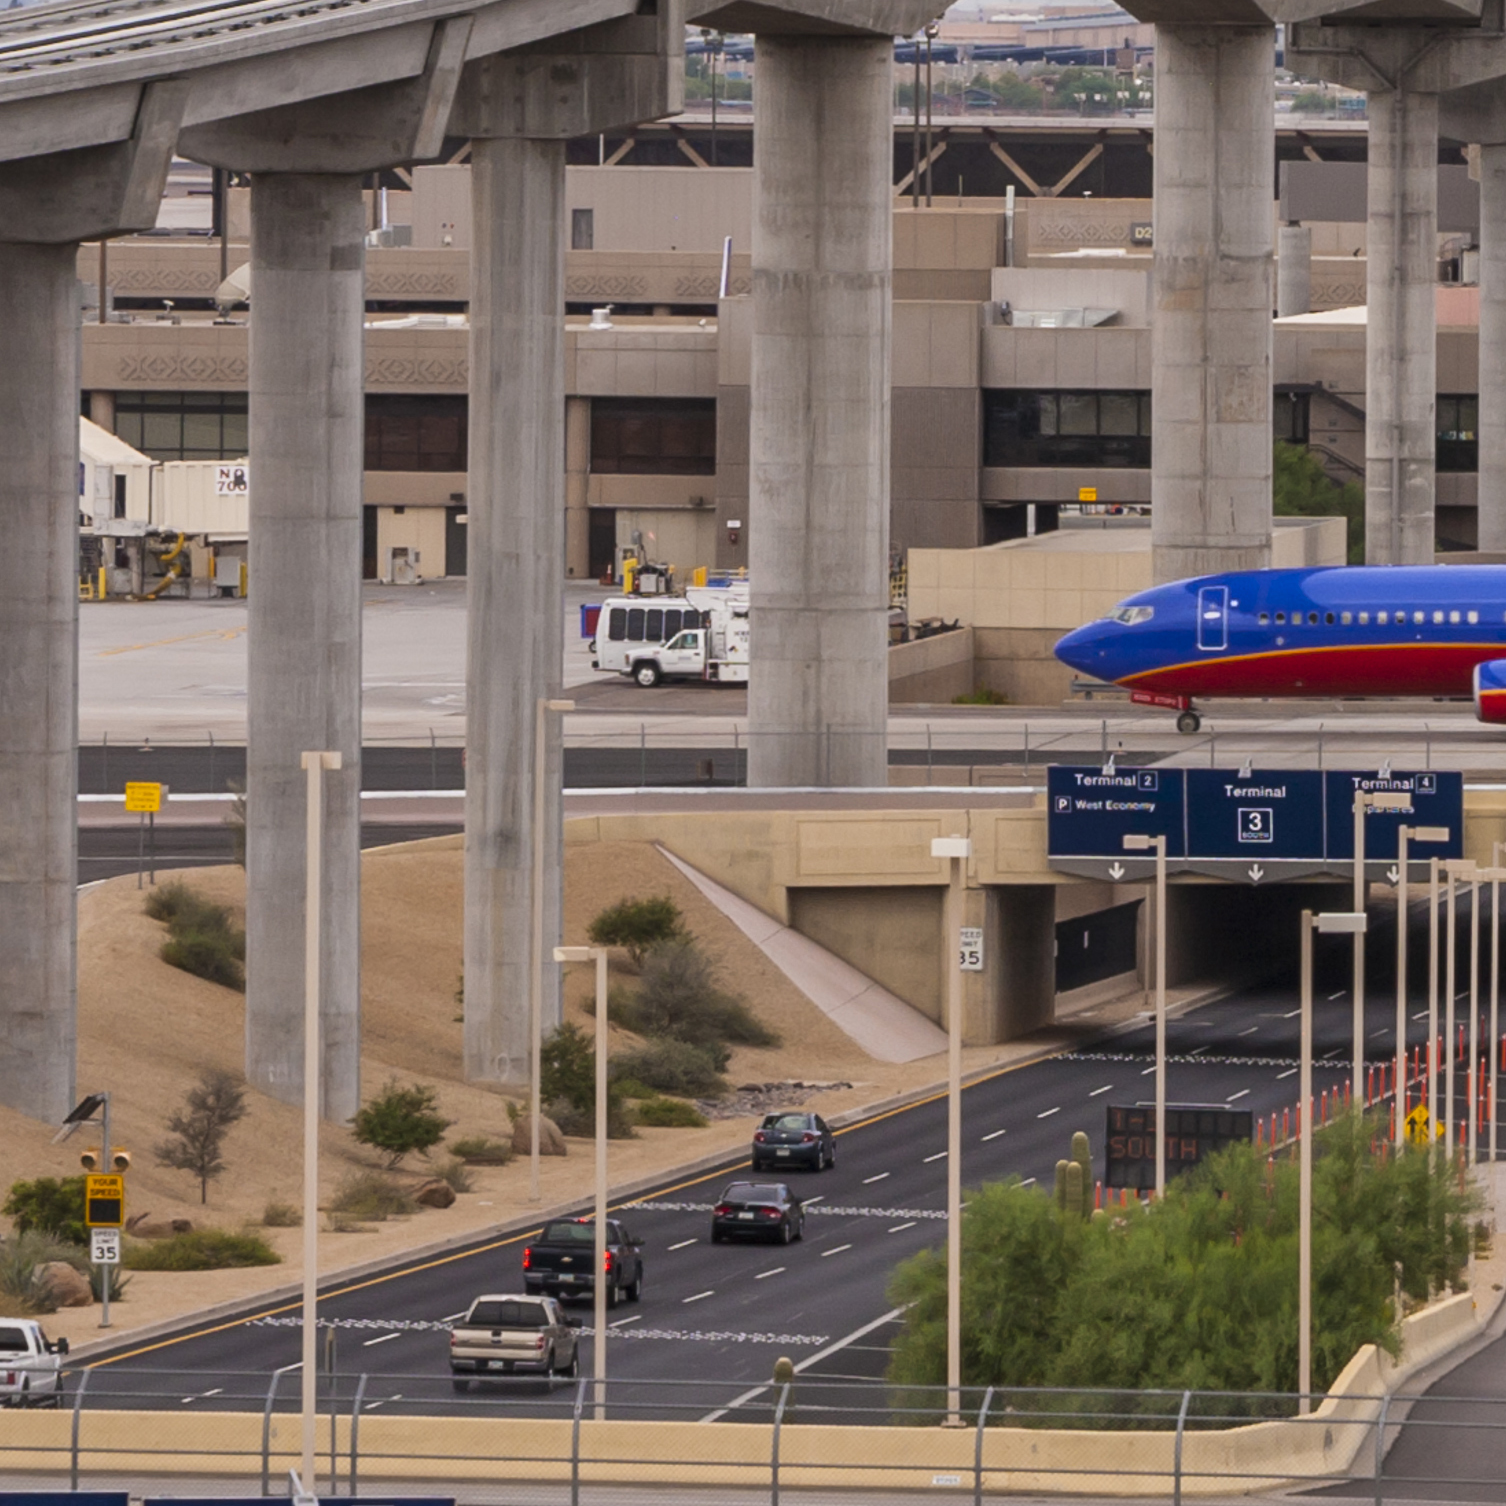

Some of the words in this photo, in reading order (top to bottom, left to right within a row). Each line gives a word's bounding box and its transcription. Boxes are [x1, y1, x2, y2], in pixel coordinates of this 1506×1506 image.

[1074, 773, 1137, 786] Terminal
[1143, 775, 1152, 787] 2
[1352, 777, 1414, 790] Terminal
[1421, 776, 1430, 787] 4
[1224, 784, 1287, 798] Terminal
[1075, 799, 1103, 811] West
[1105, 799, 1156, 813] Economy
[1248, 812, 1262, 831] 3
[95, 1246, 117, 1260] 35
